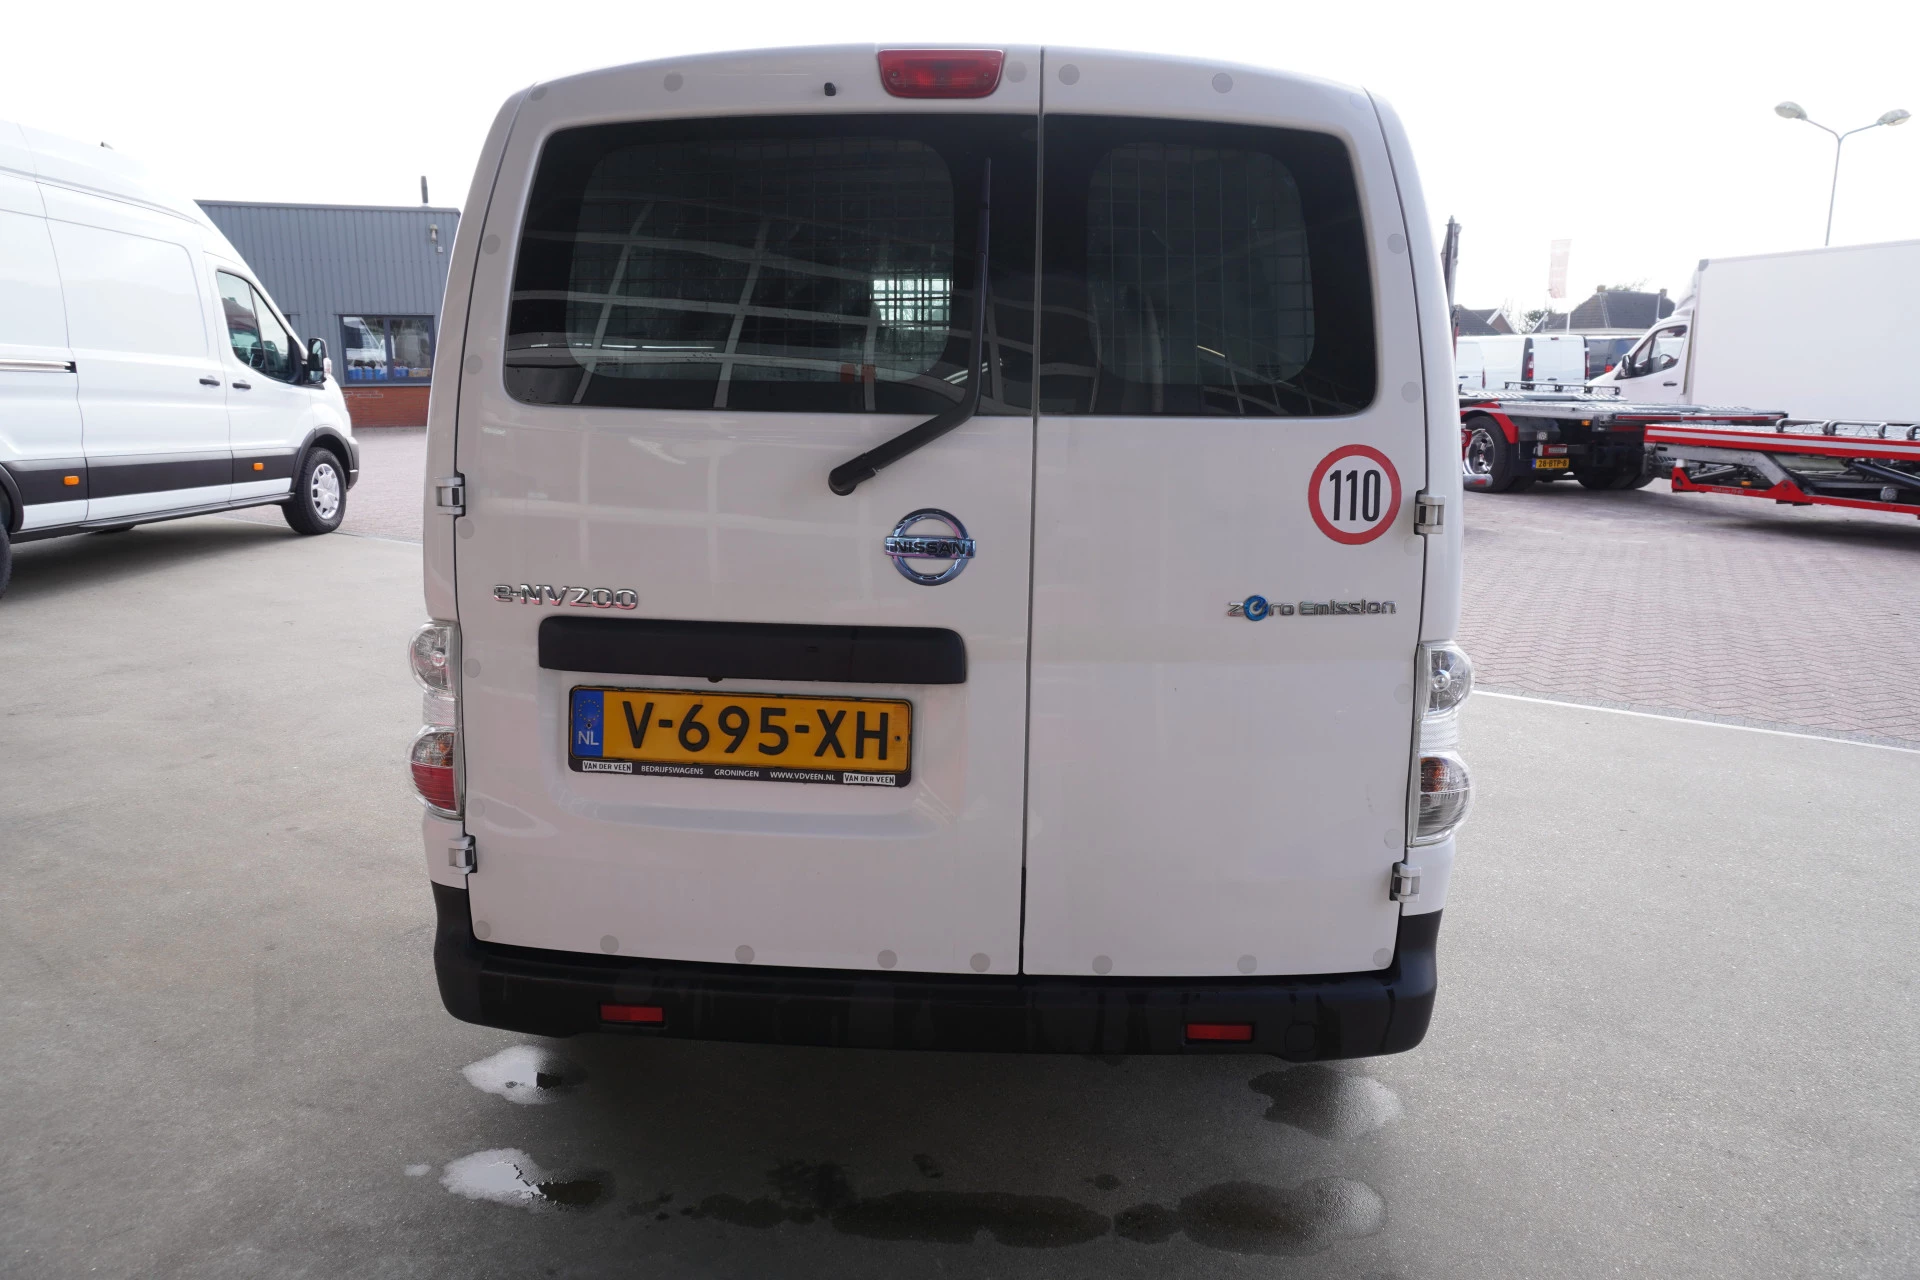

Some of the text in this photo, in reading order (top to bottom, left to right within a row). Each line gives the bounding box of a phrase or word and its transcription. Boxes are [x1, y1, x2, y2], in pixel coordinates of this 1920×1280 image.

[1329, 469, 1381, 522] 110
[894, 540, 966, 555] NISSAN
[493, 583, 638, 610] e-NV200
[1299, 599, 1396, 616] Emission
[577, 730, 599, 745] NL
[622, 701, 889, 760] V-695-XH
[583, 761, 632, 772] VAN DER VEEN
[641, 765, 704, 775] BEDRIJFSWAGENS
[714, 768, 759, 778] GRONINGEN
[770, 771, 835, 781] WWW.VDVEEN.NL
[844, 773, 895, 784] VAN DER VEEN
